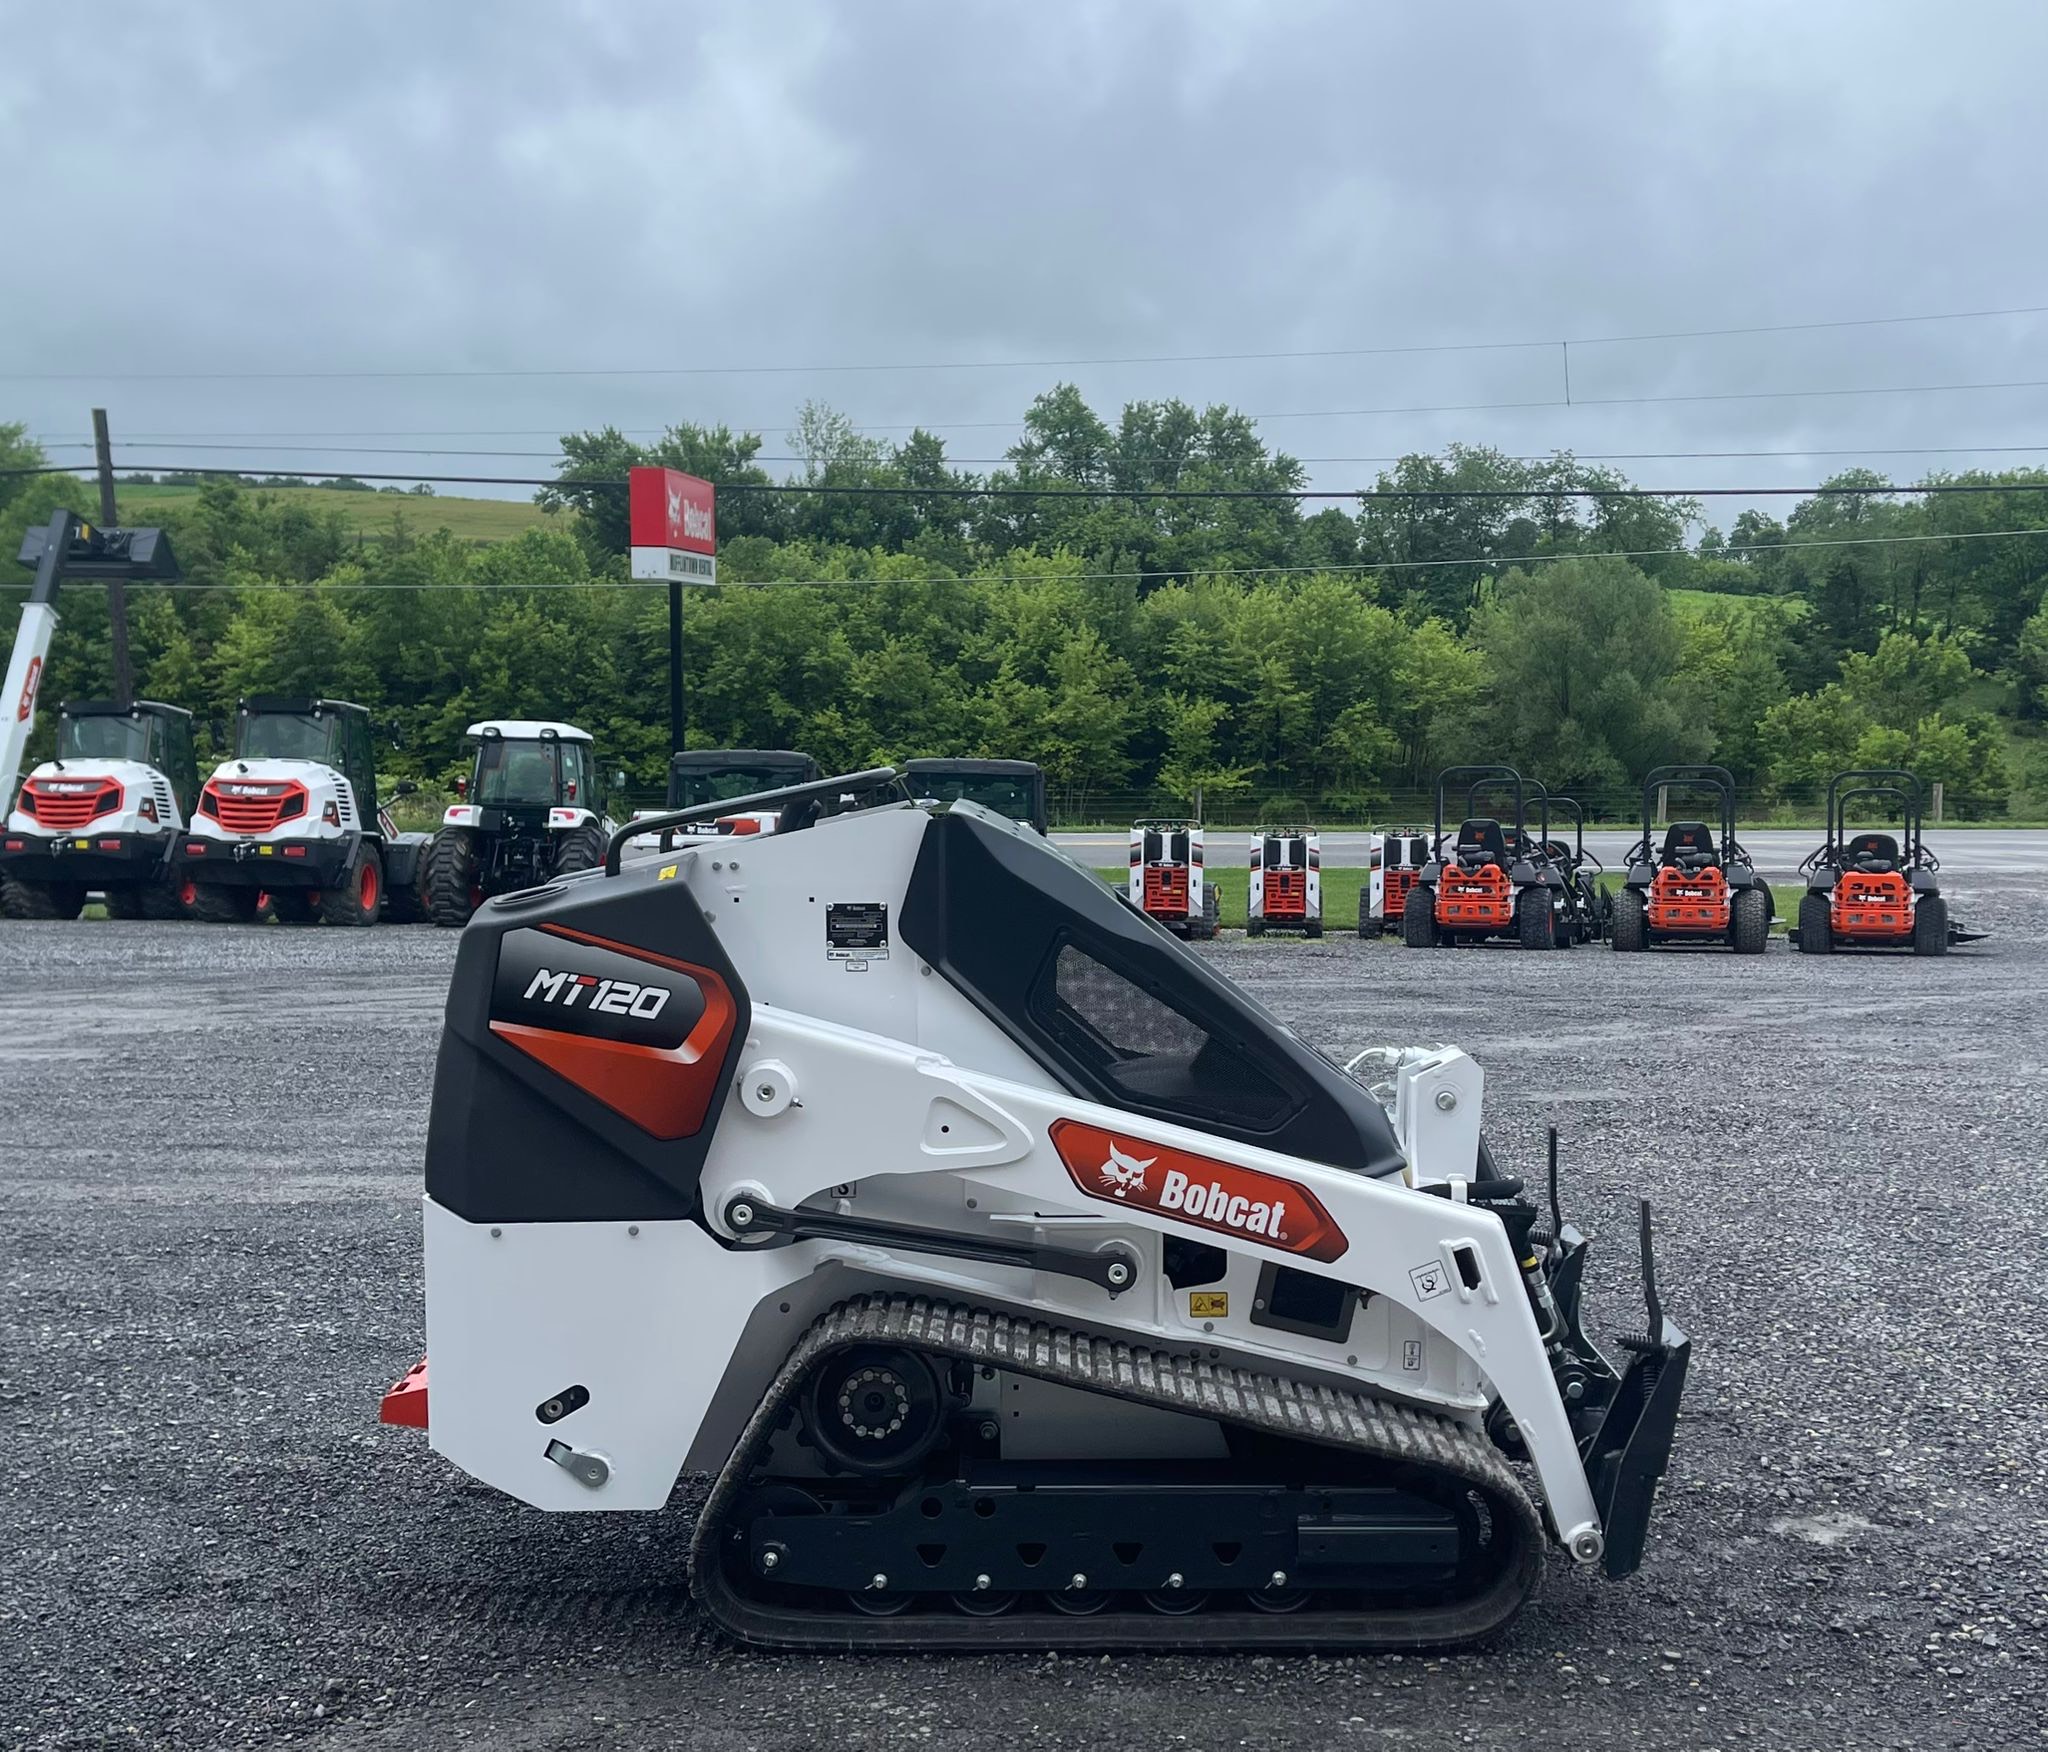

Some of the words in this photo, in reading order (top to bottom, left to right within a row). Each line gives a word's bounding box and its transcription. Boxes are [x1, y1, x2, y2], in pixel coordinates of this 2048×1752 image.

[683, 498, 712, 542] Bobcat
[58, 783, 84, 792] Bobcat
[242, 785, 268, 796] Bobcat
[697, 826, 719, 834] Bobcat
[523, 968, 671, 1020] MT120
[1159, 1169, 1286, 1239] Bobcat
